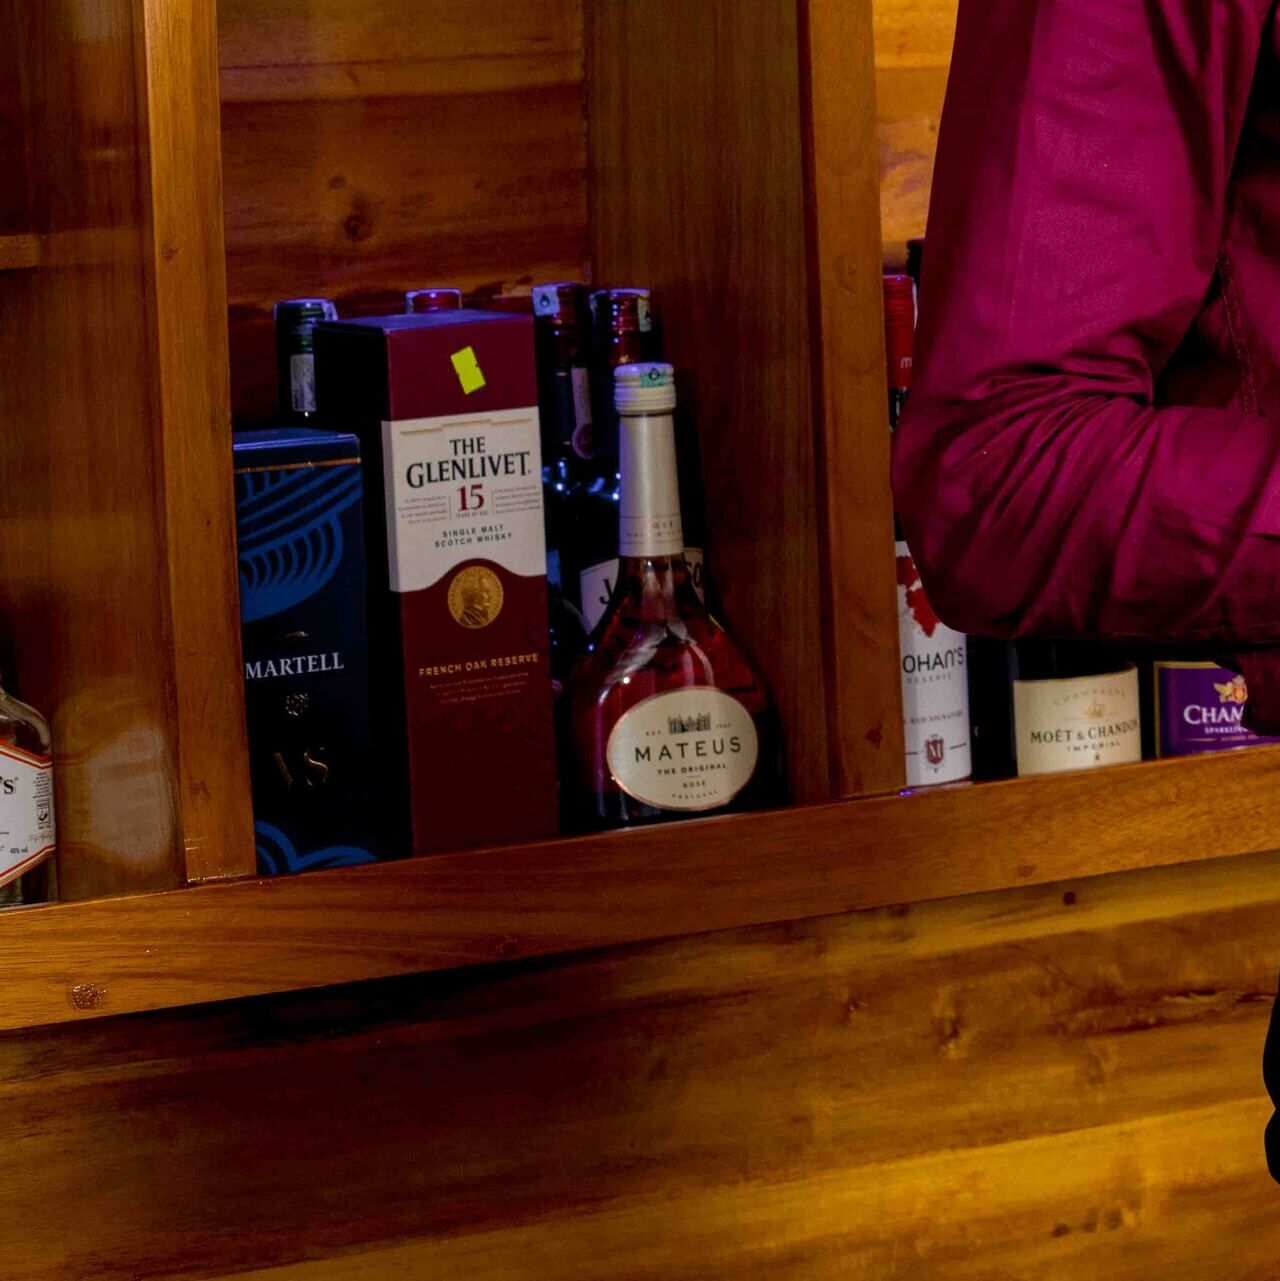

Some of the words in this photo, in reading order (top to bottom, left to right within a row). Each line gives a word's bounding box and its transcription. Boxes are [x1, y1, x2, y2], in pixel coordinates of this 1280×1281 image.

[449, 437, 486, 457] THE
[406, 451, 532, 489] GLENLIVET
[456, 483, 485, 511] 15
[435, 537, 472, 548] SCOTCH
[477, 533, 513, 544] WHISKY
[442, 527, 476, 538] SINGLE
[481, 524, 504, 534] MALT
[245, 652, 344, 679] MARTELL
[419, 664, 462, 677] FRENCH
[465, 660, 488, 672] OAK
[490, 652, 539, 667] RESERVE
[1030, 729, 1073, 743] MOËT
[1076, 732, 1084, 741] &
[635, 736, 741, 762] MATEUS
[658, 768, 676, 776] THE
[681, 763, 728, 773] ORIGINAL
